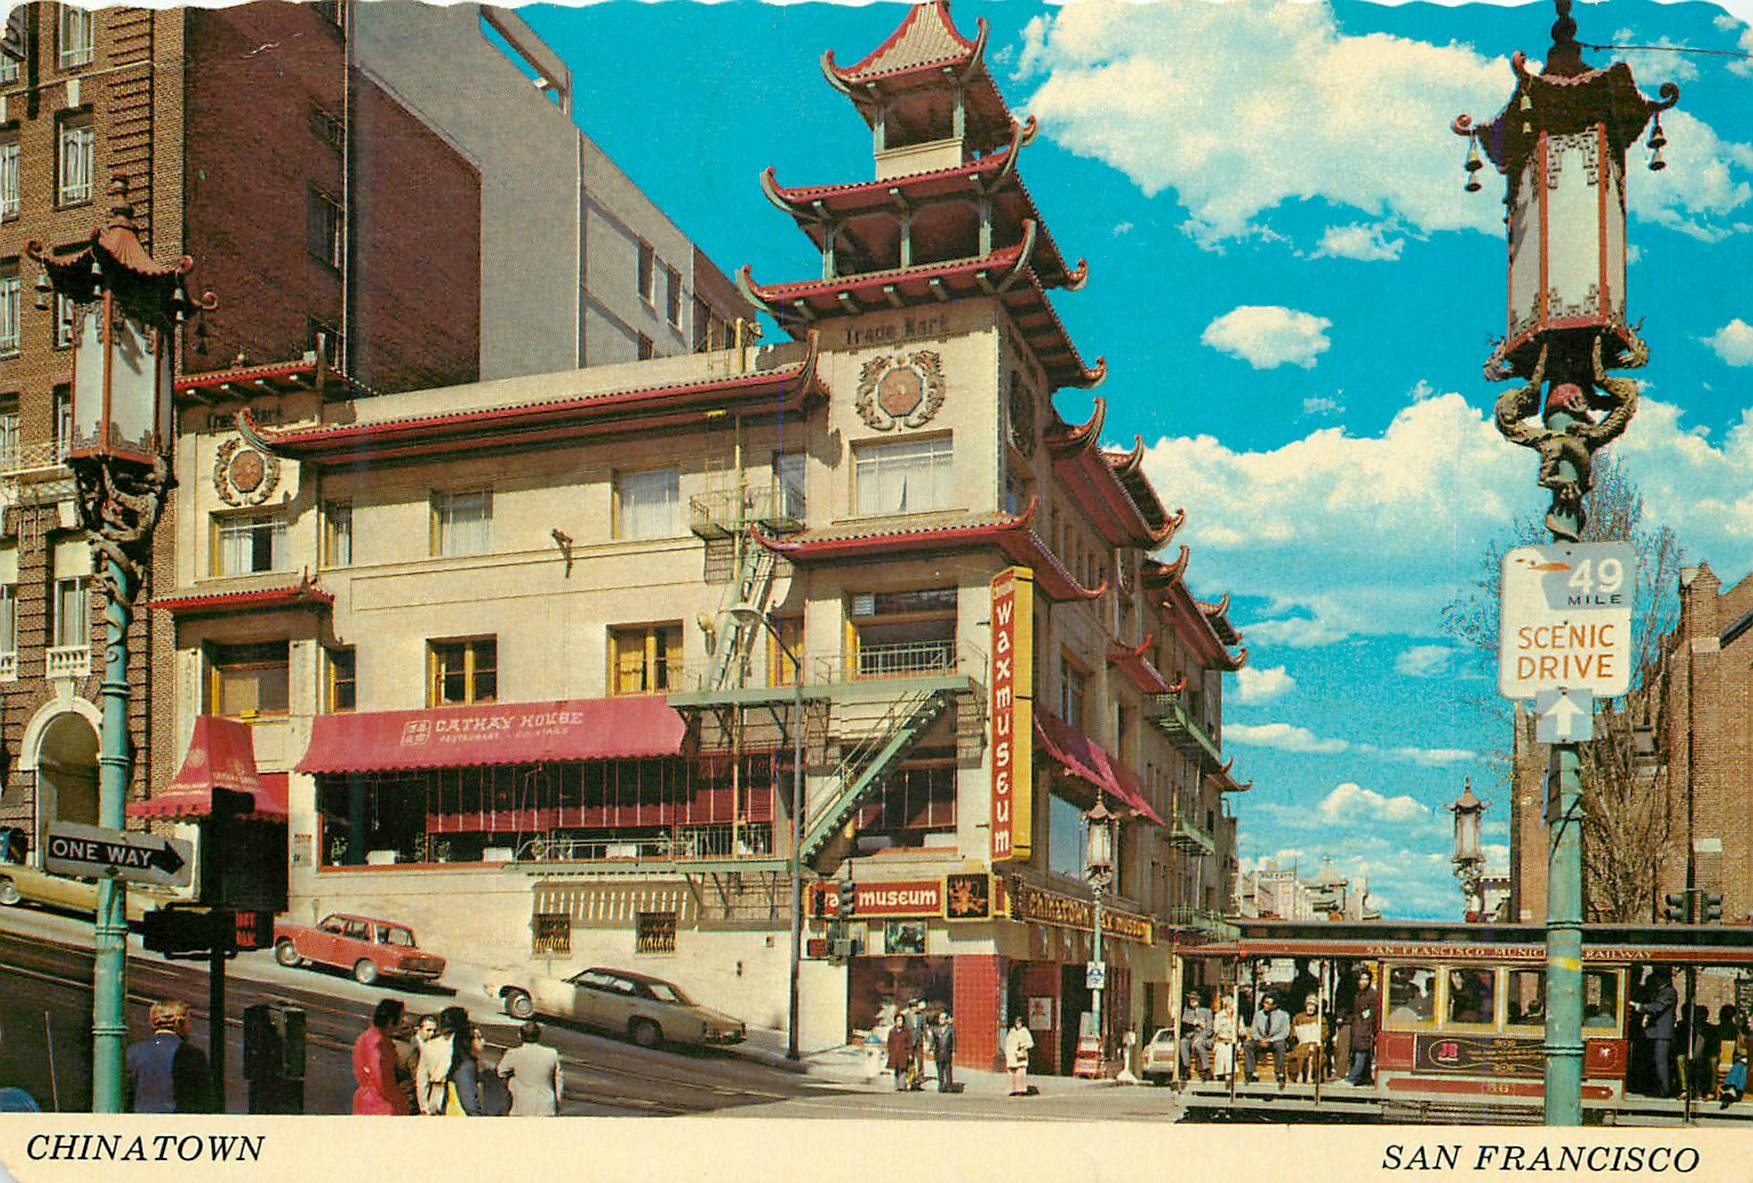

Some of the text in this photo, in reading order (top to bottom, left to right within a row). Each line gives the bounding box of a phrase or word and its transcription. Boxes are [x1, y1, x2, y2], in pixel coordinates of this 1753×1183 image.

[1568, 558, 1623, 595] 49
[1568, 594, 1622, 605] MILE
[1518, 624, 1615, 650] SCENIC
[1517, 654, 1615, 681] DRIVE
[435, 715, 514, 733] CATHAY
[520, 711, 584, 728] HOUSE
[52, 839, 152, 867] ONE WAY
[858, 889, 937, 907] museum
[1366, 945, 1651, 959] SAN FRANCISCO MUNICI RAILWAY
